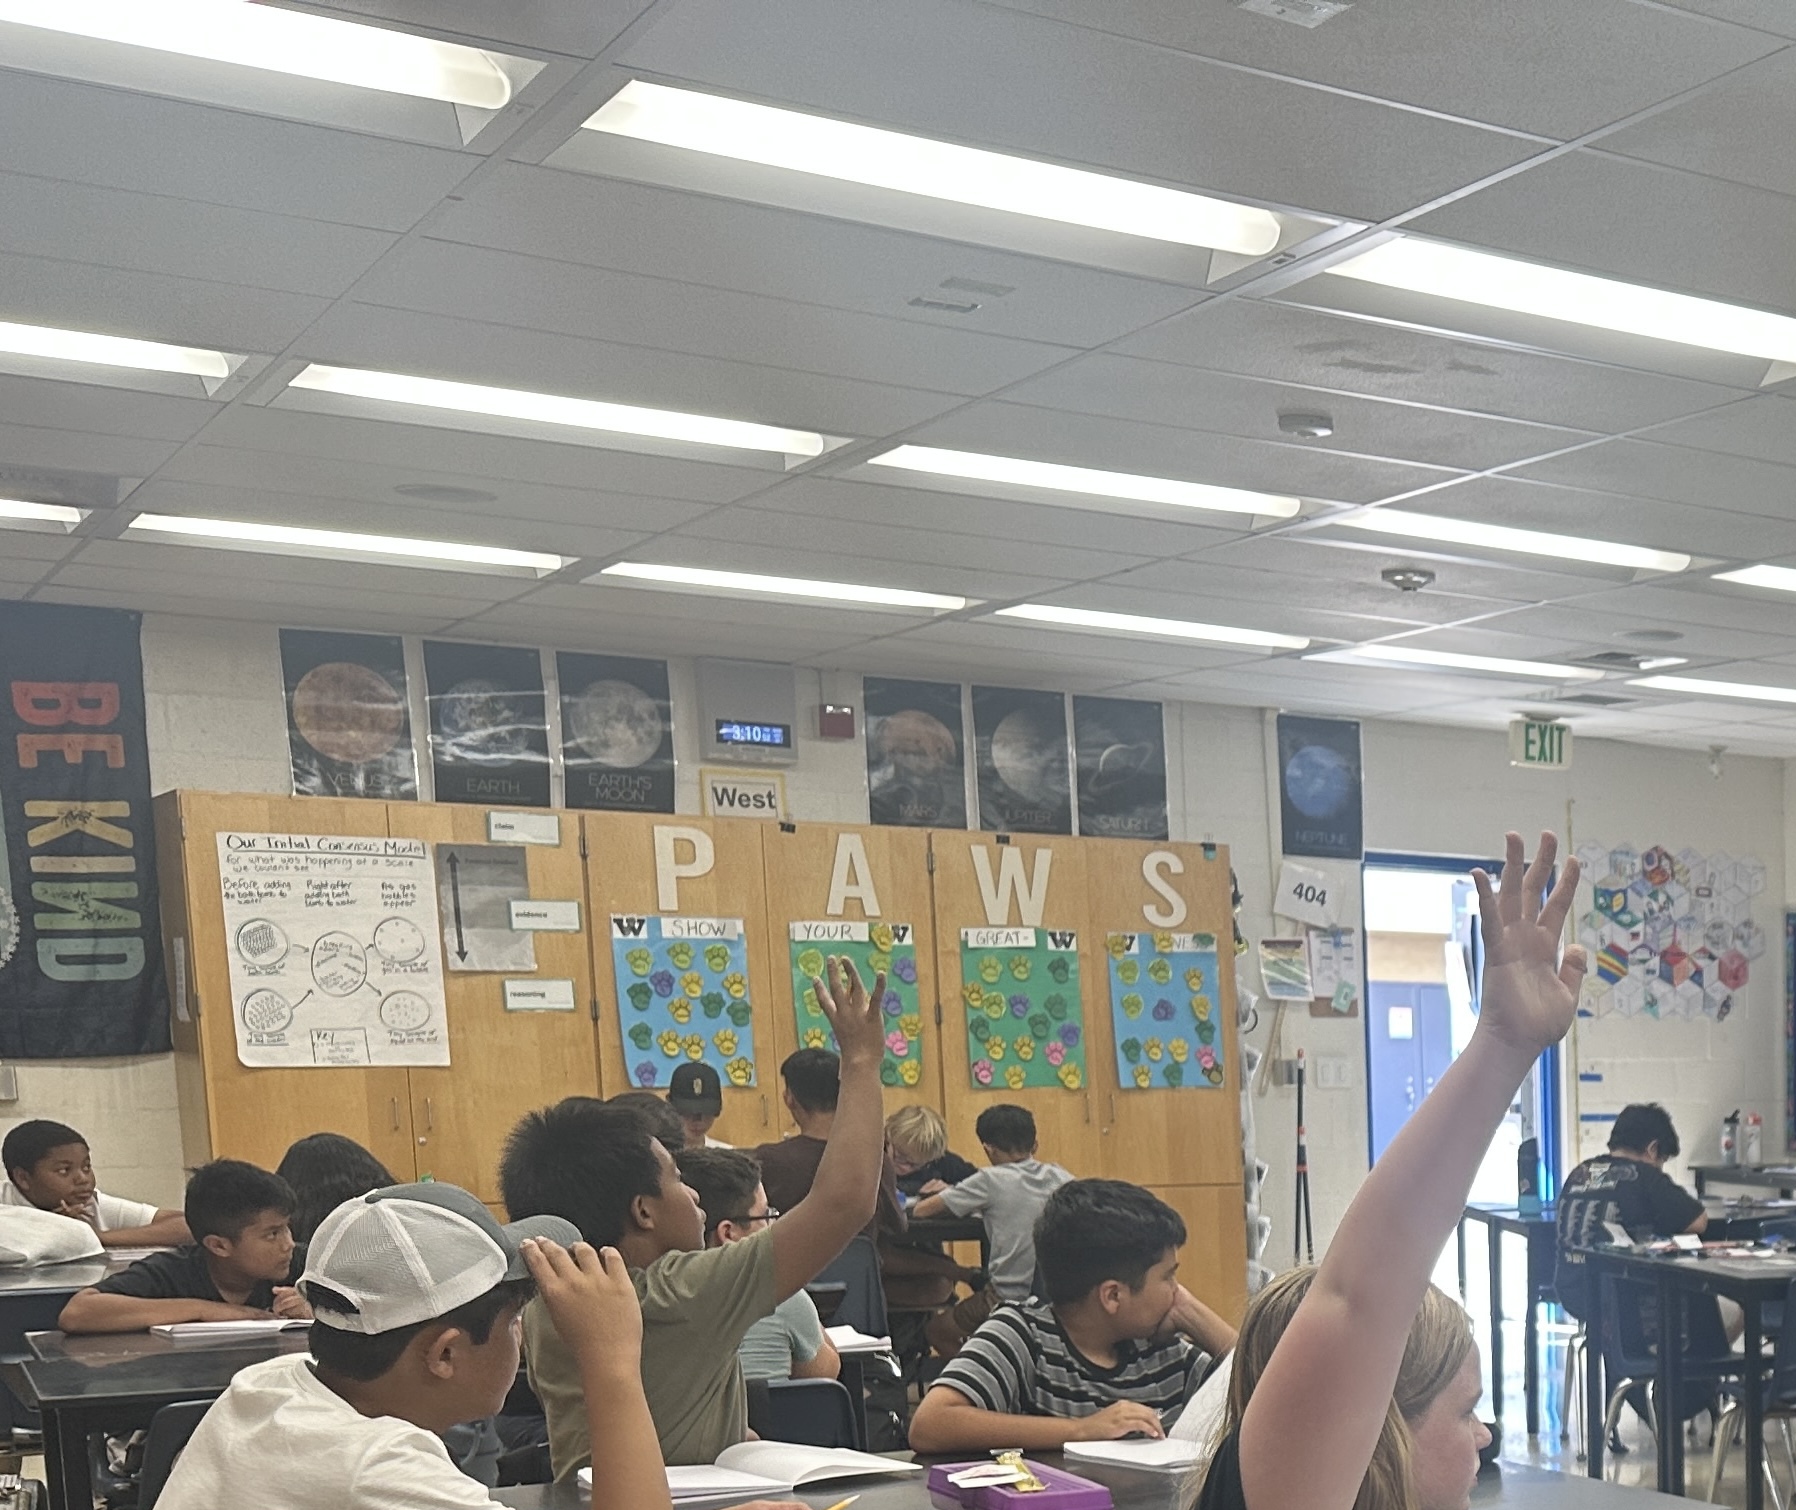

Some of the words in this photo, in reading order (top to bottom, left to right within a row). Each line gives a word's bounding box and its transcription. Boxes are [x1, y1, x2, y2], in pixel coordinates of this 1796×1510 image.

[11, 681, 120, 768] BE
[1525, 723, 1566, 764] EXIT
[466, 777, 520, 795] EARTH
[589, 772, 653, 790] EARTH'S
[595, 787, 645, 802] MOON
[711, 786, 776, 809] West
[902, 804, 938, 817] MARS
[1004, 809, 1052, 822] JUPITER
[226, 834, 256, 850] Our
[267, 835, 310, 850] Initial
[317, 837, 380, 852] Consensus
[384, 840, 425, 855] Model
[1295, 831, 1348, 846] NEPTUNE
[248, 856, 274, 864] what
[305, 856, 353, 870] happening
[24, 800, 146, 981] KIND
[223, 877, 258, 890] Before
[1293, 882, 1327, 906] 404
[671, 919, 726, 937] SHOW
[803, 923, 852, 940] YOUR
[315, 1031, 335, 1045] Key
